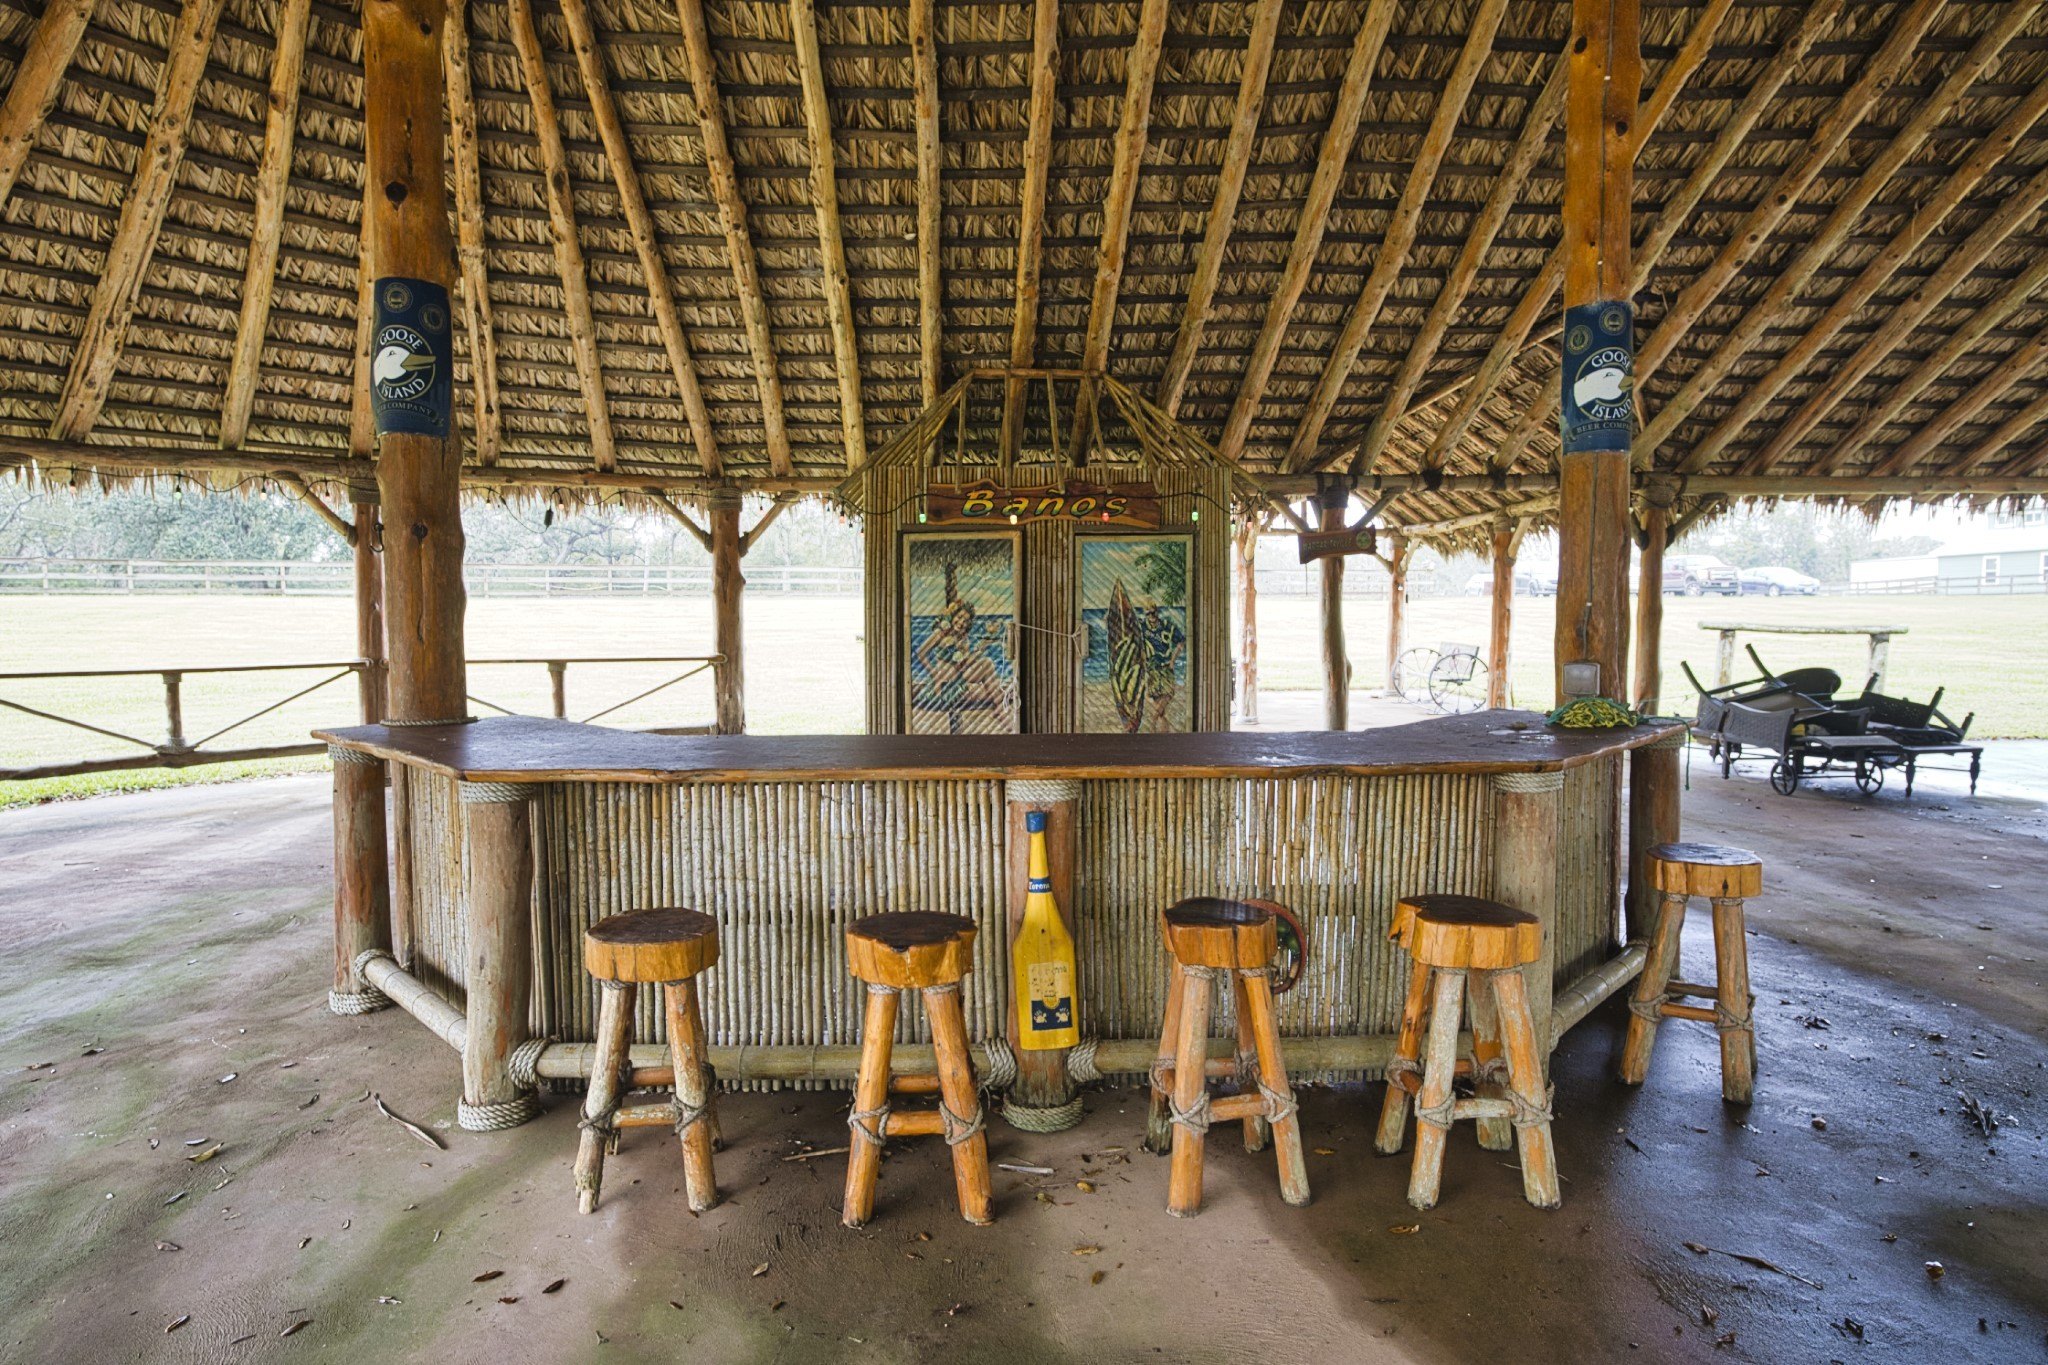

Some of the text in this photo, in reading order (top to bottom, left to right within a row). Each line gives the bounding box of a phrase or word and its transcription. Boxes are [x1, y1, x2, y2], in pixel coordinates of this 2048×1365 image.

[379, 328, 423, 350] GOOSE
[380, 378, 426, 399] ISLAND
[387, 402, 433, 416] COMPANY
[1591, 399, 1632, 419] ISLAND
[1576, 422, 1600, 433] BEER
[961, 488, 1129, 519] Baños
